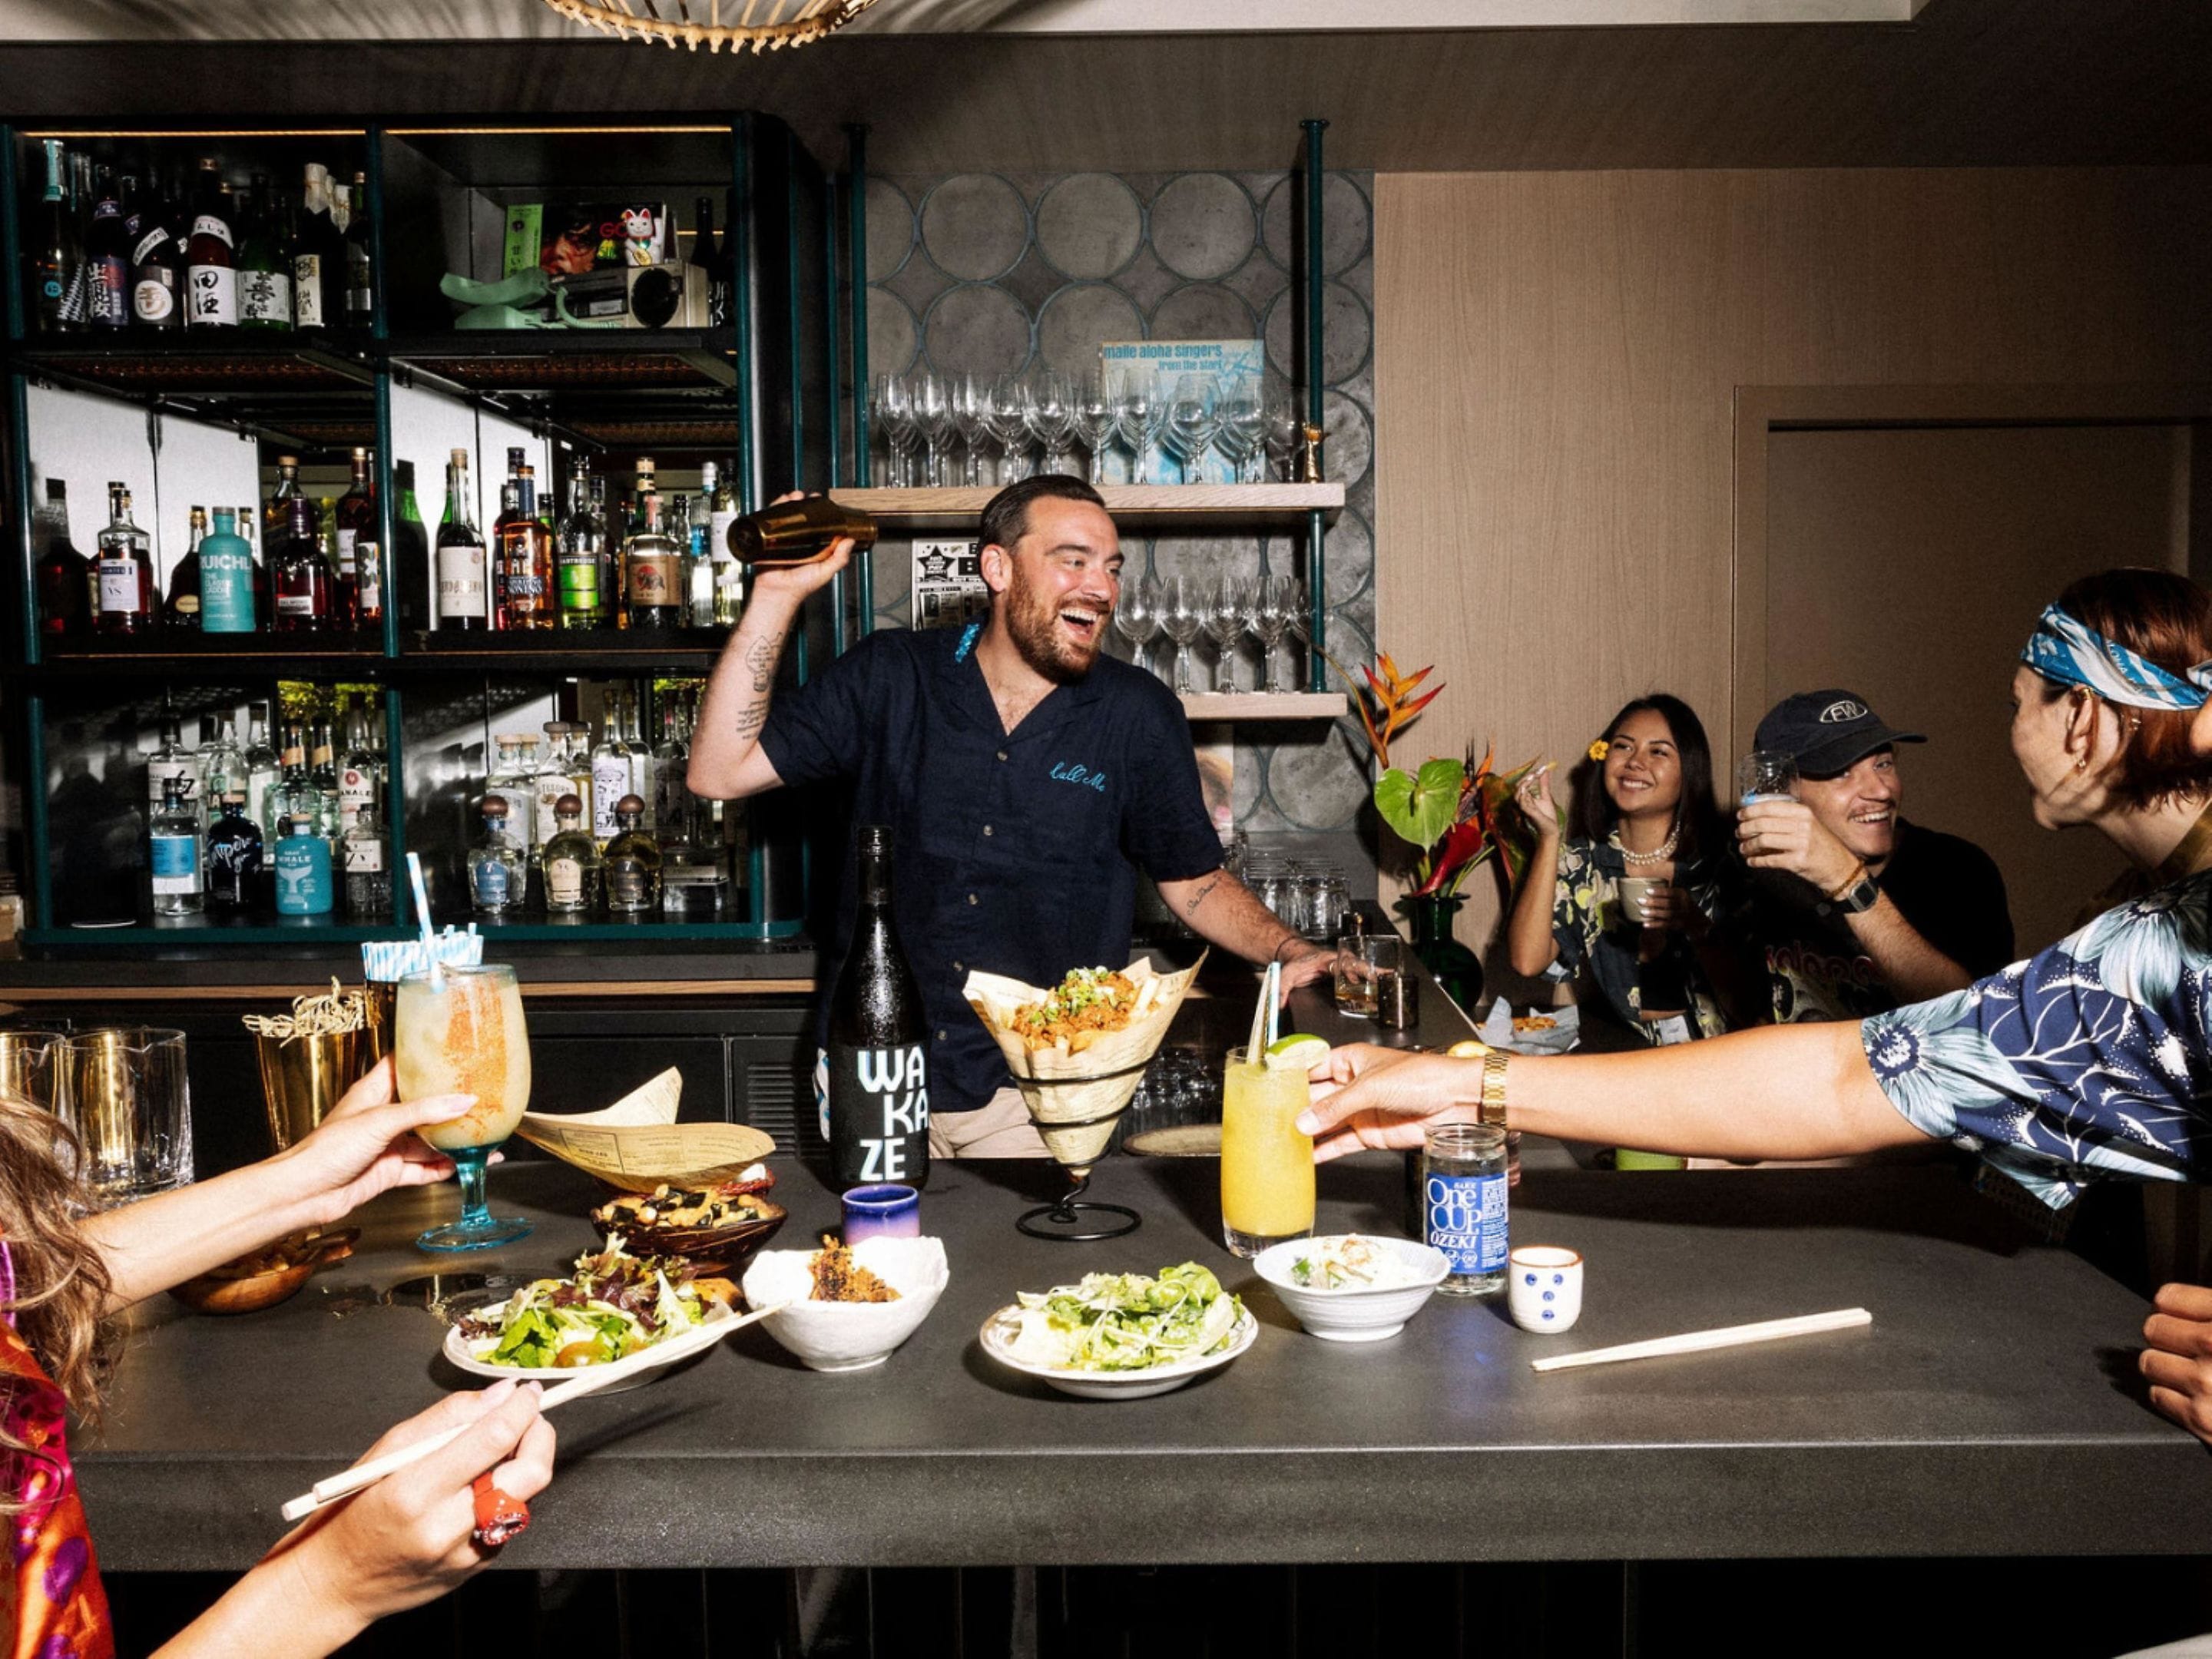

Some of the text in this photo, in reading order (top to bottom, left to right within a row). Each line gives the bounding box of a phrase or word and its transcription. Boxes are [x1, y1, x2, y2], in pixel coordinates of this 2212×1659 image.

[1140, 344, 1172, 358] aloha
[1174, 343, 1223, 359] singers
[1158, 359, 1223, 370] from the start
[858, 1046, 925, 1092] WA
[883, 1088, 929, 1137] KA
[859, 1138, 906, 1181] ZE
[1427, 1177, 1477, 1208] One
[1430, 1230, 1477, 1249] OZEKI
